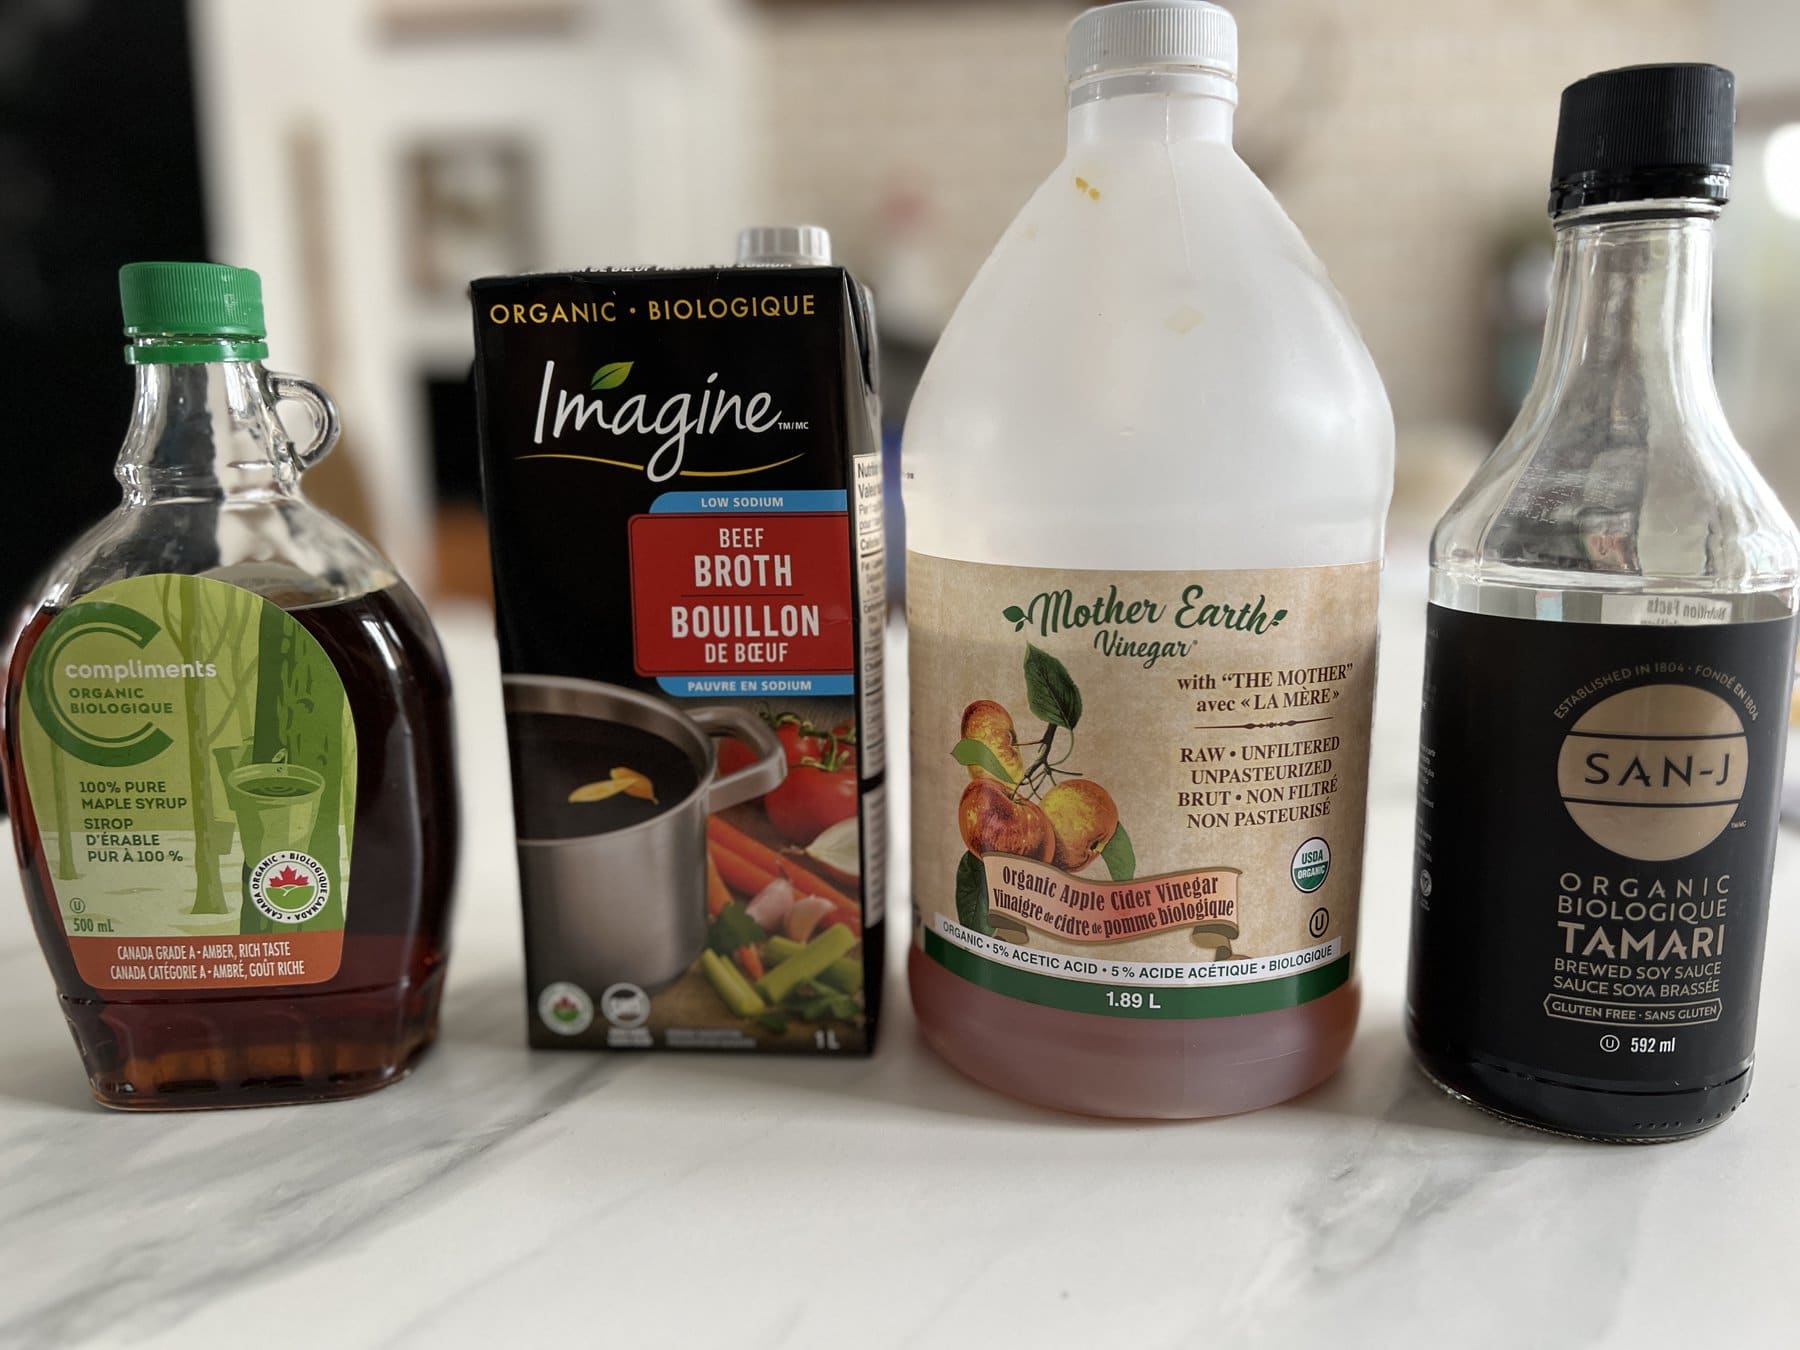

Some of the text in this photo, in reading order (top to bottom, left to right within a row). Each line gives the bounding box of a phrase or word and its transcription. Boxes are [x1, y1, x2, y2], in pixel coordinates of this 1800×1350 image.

[490, 294, 815, 325] ORGANIC BIOLOGIQUE
[534, 360, 782, 483] Imagine
[778, 422, 809, 430] TM/MC
[701, 497, 784, 508] LOW SODIUM
[719, 528, 764, 548] BEEF
[694, 554, 792, 587] BROTH
[671, 605, 820, 638] BOUILLON
[1029, 584, 1272, 637] Mother Earth
[705, 642, 788, 663] DE BŒUF
[65, 660, 217, 683] compliments
[1178, 674, 1216, 690] with
[69, 688, 144, 699] ORGANIC
[688, 680, 812, 691] PAUVRE EN SODIUM
[1553, 662, 1759, 721] ESTABLISHED IN 1804 FONDÉ EN 1804
[70, 703, 173, 714] BIOLOGIQUE
[1197, 699, 1235, 712] avec
[1180, 736, 1340, 763] RAW UNFILTERED
[1191, 758, 1332, 784] UNPASTEURIZED
[1584, 753, 1730, 787] SAN-J
[80, 781, 166, 793] 100% PURE
[1178, 774, 1338, 807] BRUT NON FILTRÉ
[82, 798, 187, 809] MAPLE SYRUP
[1187, 796, 1331, 828] NON PASTEURISÉ
[84, 818, 133, 829] SIROP
[88, 851, 119, 862] PUR
[123, 848, 136, 862] À
[1301, 849, 1324, 865] USDA
[253, 855, 278, 890] ORGANIC
[290, 853, 327, 893] BIOLOGIQUE
[1297, 865, 1326, 880] ORGANIC
[1003, 866, 1218, 911] Organic Apple Cider Vinegar
[1560, 872, 1730, 898] ORGANIC
[254, 892, 282, 919] CANADA
[295, 896, 325, 920] CANADA
[993, 888, 1234, 938] Vinaigre de cidre de pomme biologique
[1557, 895, 1728, 925] BIOLOGIQUE
[74, 918, 114, 932] 500 mL
[118, 946, 153, 960] CANADA
[156, 945, 187, 959] GRADE
[239, 943, 260, 957] RICH
[262, 941, 291, 957] TASTE
[943, 921, 984, 949] ORGANIC
[992, 943, 1009, 958] 5%
[1012, 950, 1060, 969] ACETIC
[1063, 960, 1098, 974] ACID
[1139, 969, 1184, 979] ACIDE
[1188, 962, 1258, 979] ACÉTIQUE
[1269, 944, 1333, 971] BIOLOGIQUE
[1557, 920, 1725, 961] TAMARI
[111, 966, 145, 979] CANADA
[148, 961, 197, 979] CATÉGORIE
[249, 958, 275, 977] GOÛT
[277, 960, 305, 975] RICHE
[1554, 958, 1722, 980] BREWED SOY SAUCE
[1553, 975, 1719, 997] SAUCE SOYA BRASSÉE
[1105, 992, 1161, 1009] 1.89 L
[1551, 1001, 1717, 1021] GLUTEN FREE SANS GLUTEN
[1631, 1037, 1675, 1053] 592 ml
